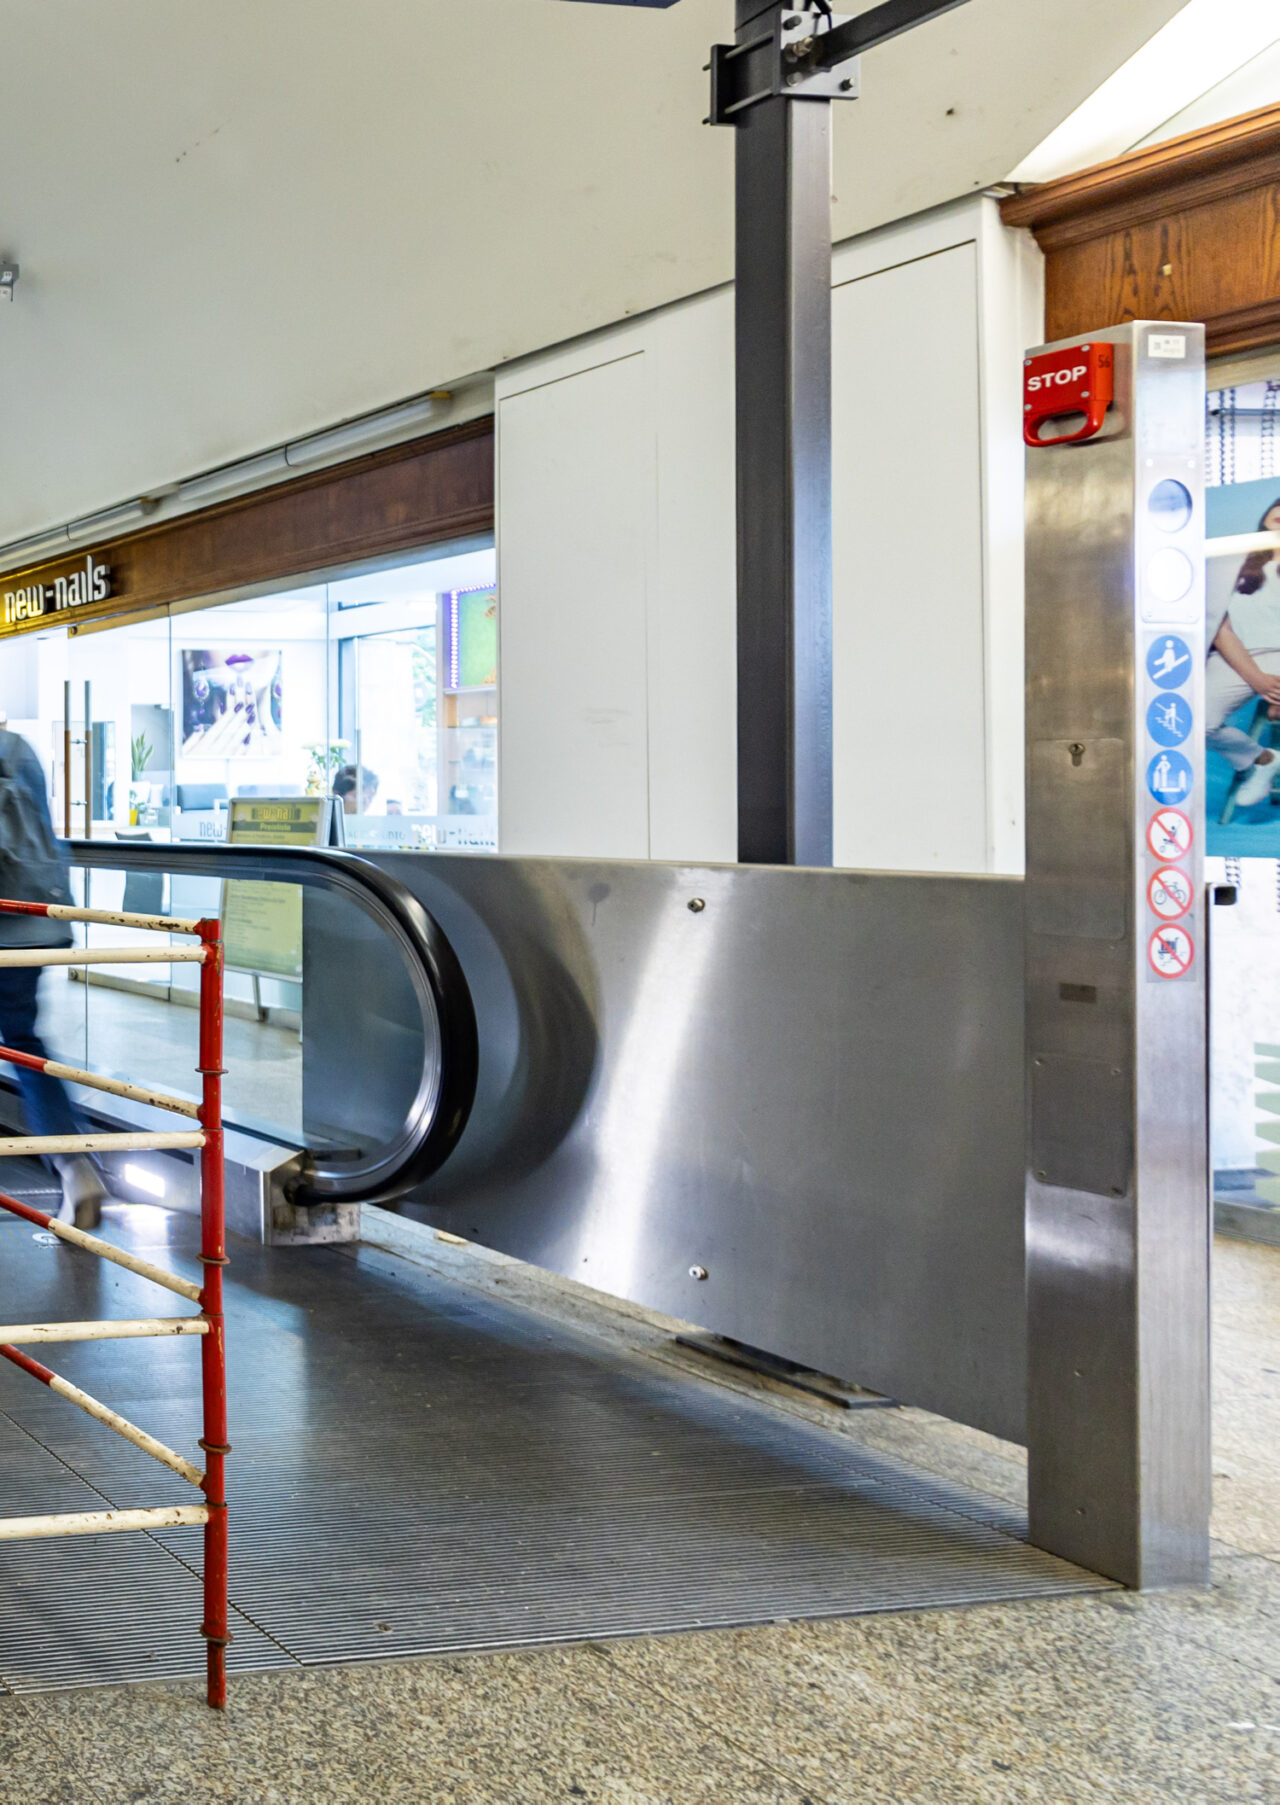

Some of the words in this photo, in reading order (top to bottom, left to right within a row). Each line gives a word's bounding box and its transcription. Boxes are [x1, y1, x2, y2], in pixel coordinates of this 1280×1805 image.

[1097, 354, 1111, 369] 56
[1027, 365, 1088, 392] STOP
[3, 554, 108, 624] new-nails
